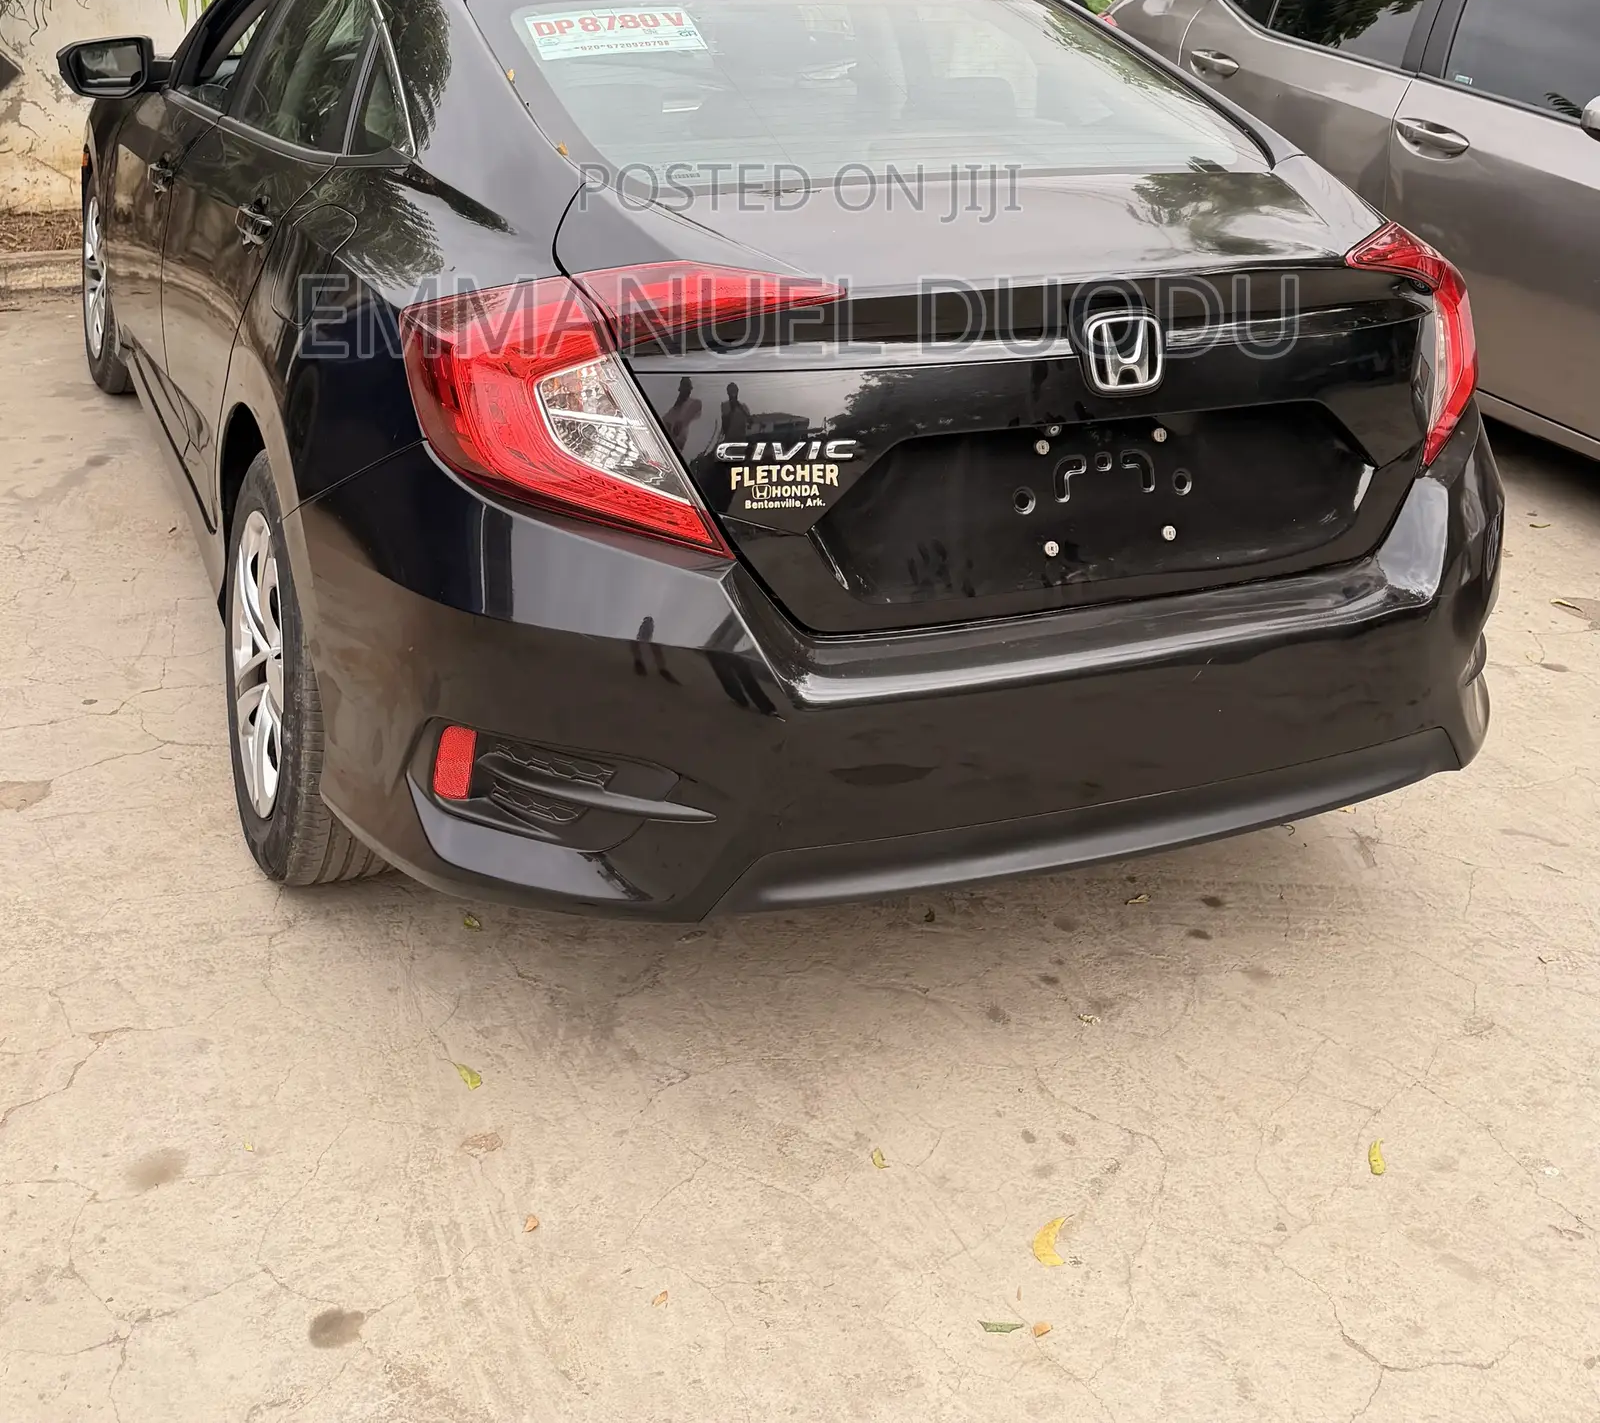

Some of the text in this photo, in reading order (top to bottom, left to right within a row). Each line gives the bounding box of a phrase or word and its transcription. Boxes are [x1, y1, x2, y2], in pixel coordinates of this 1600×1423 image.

[533, 11, 685, 37] DP 8780 V
[716, 440, 857, 462] CIVIC
[730, 463, 840, 491] FLETCHER
[772, 485, 820, 498] HONDA
[744, 497, 826, 510] Bentonville, Ark.
